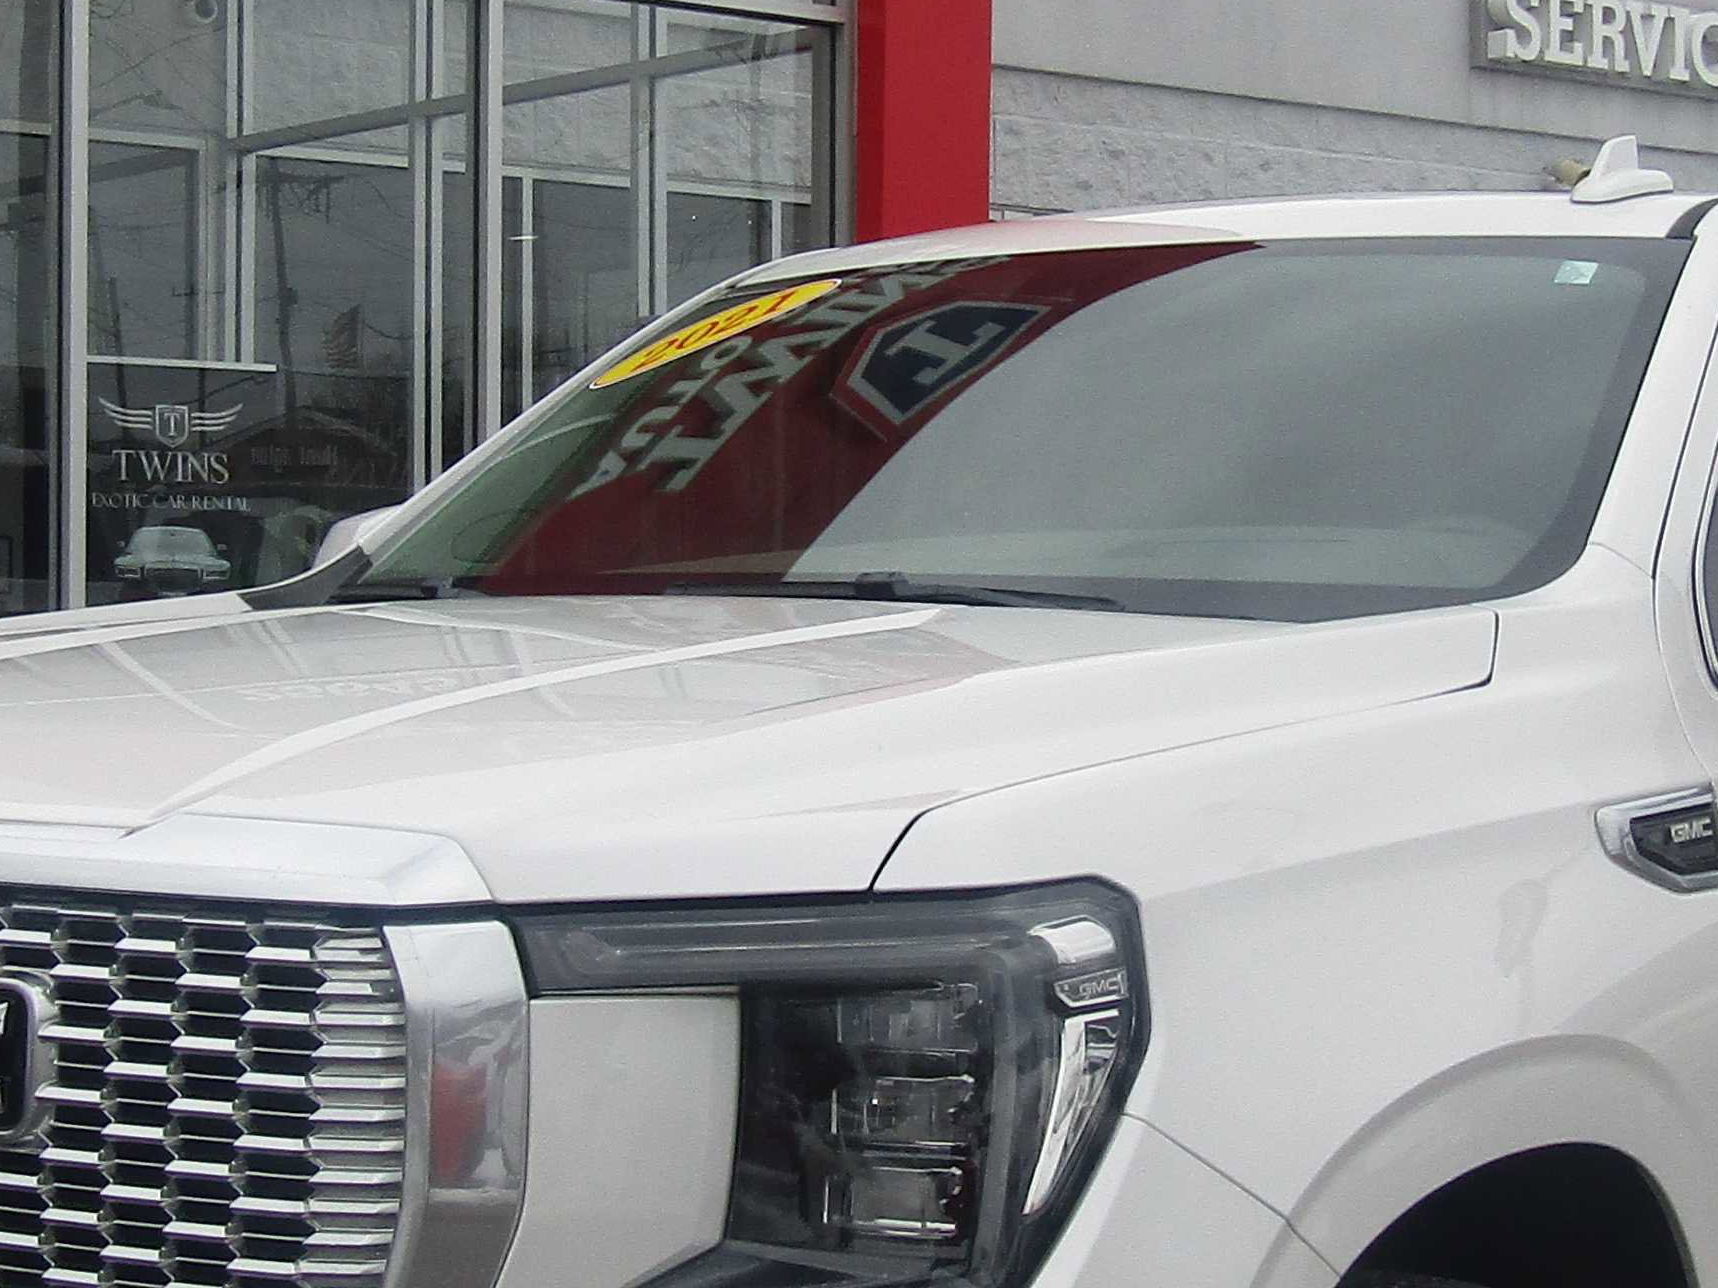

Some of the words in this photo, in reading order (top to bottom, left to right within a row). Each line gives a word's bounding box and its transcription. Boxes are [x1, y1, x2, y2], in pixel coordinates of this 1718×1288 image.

[630, 289, 796, 374] 2021
[112, 449, 230, 484] TWINS
[91, 492, 149, 508] EXOTIC
[152, 494, 188, 510] CAR
[191, 496, 252, 512] RENTAL
[1670, 817, 1713, 843] GMC
[1079, 976, 1119, 995] GMC
